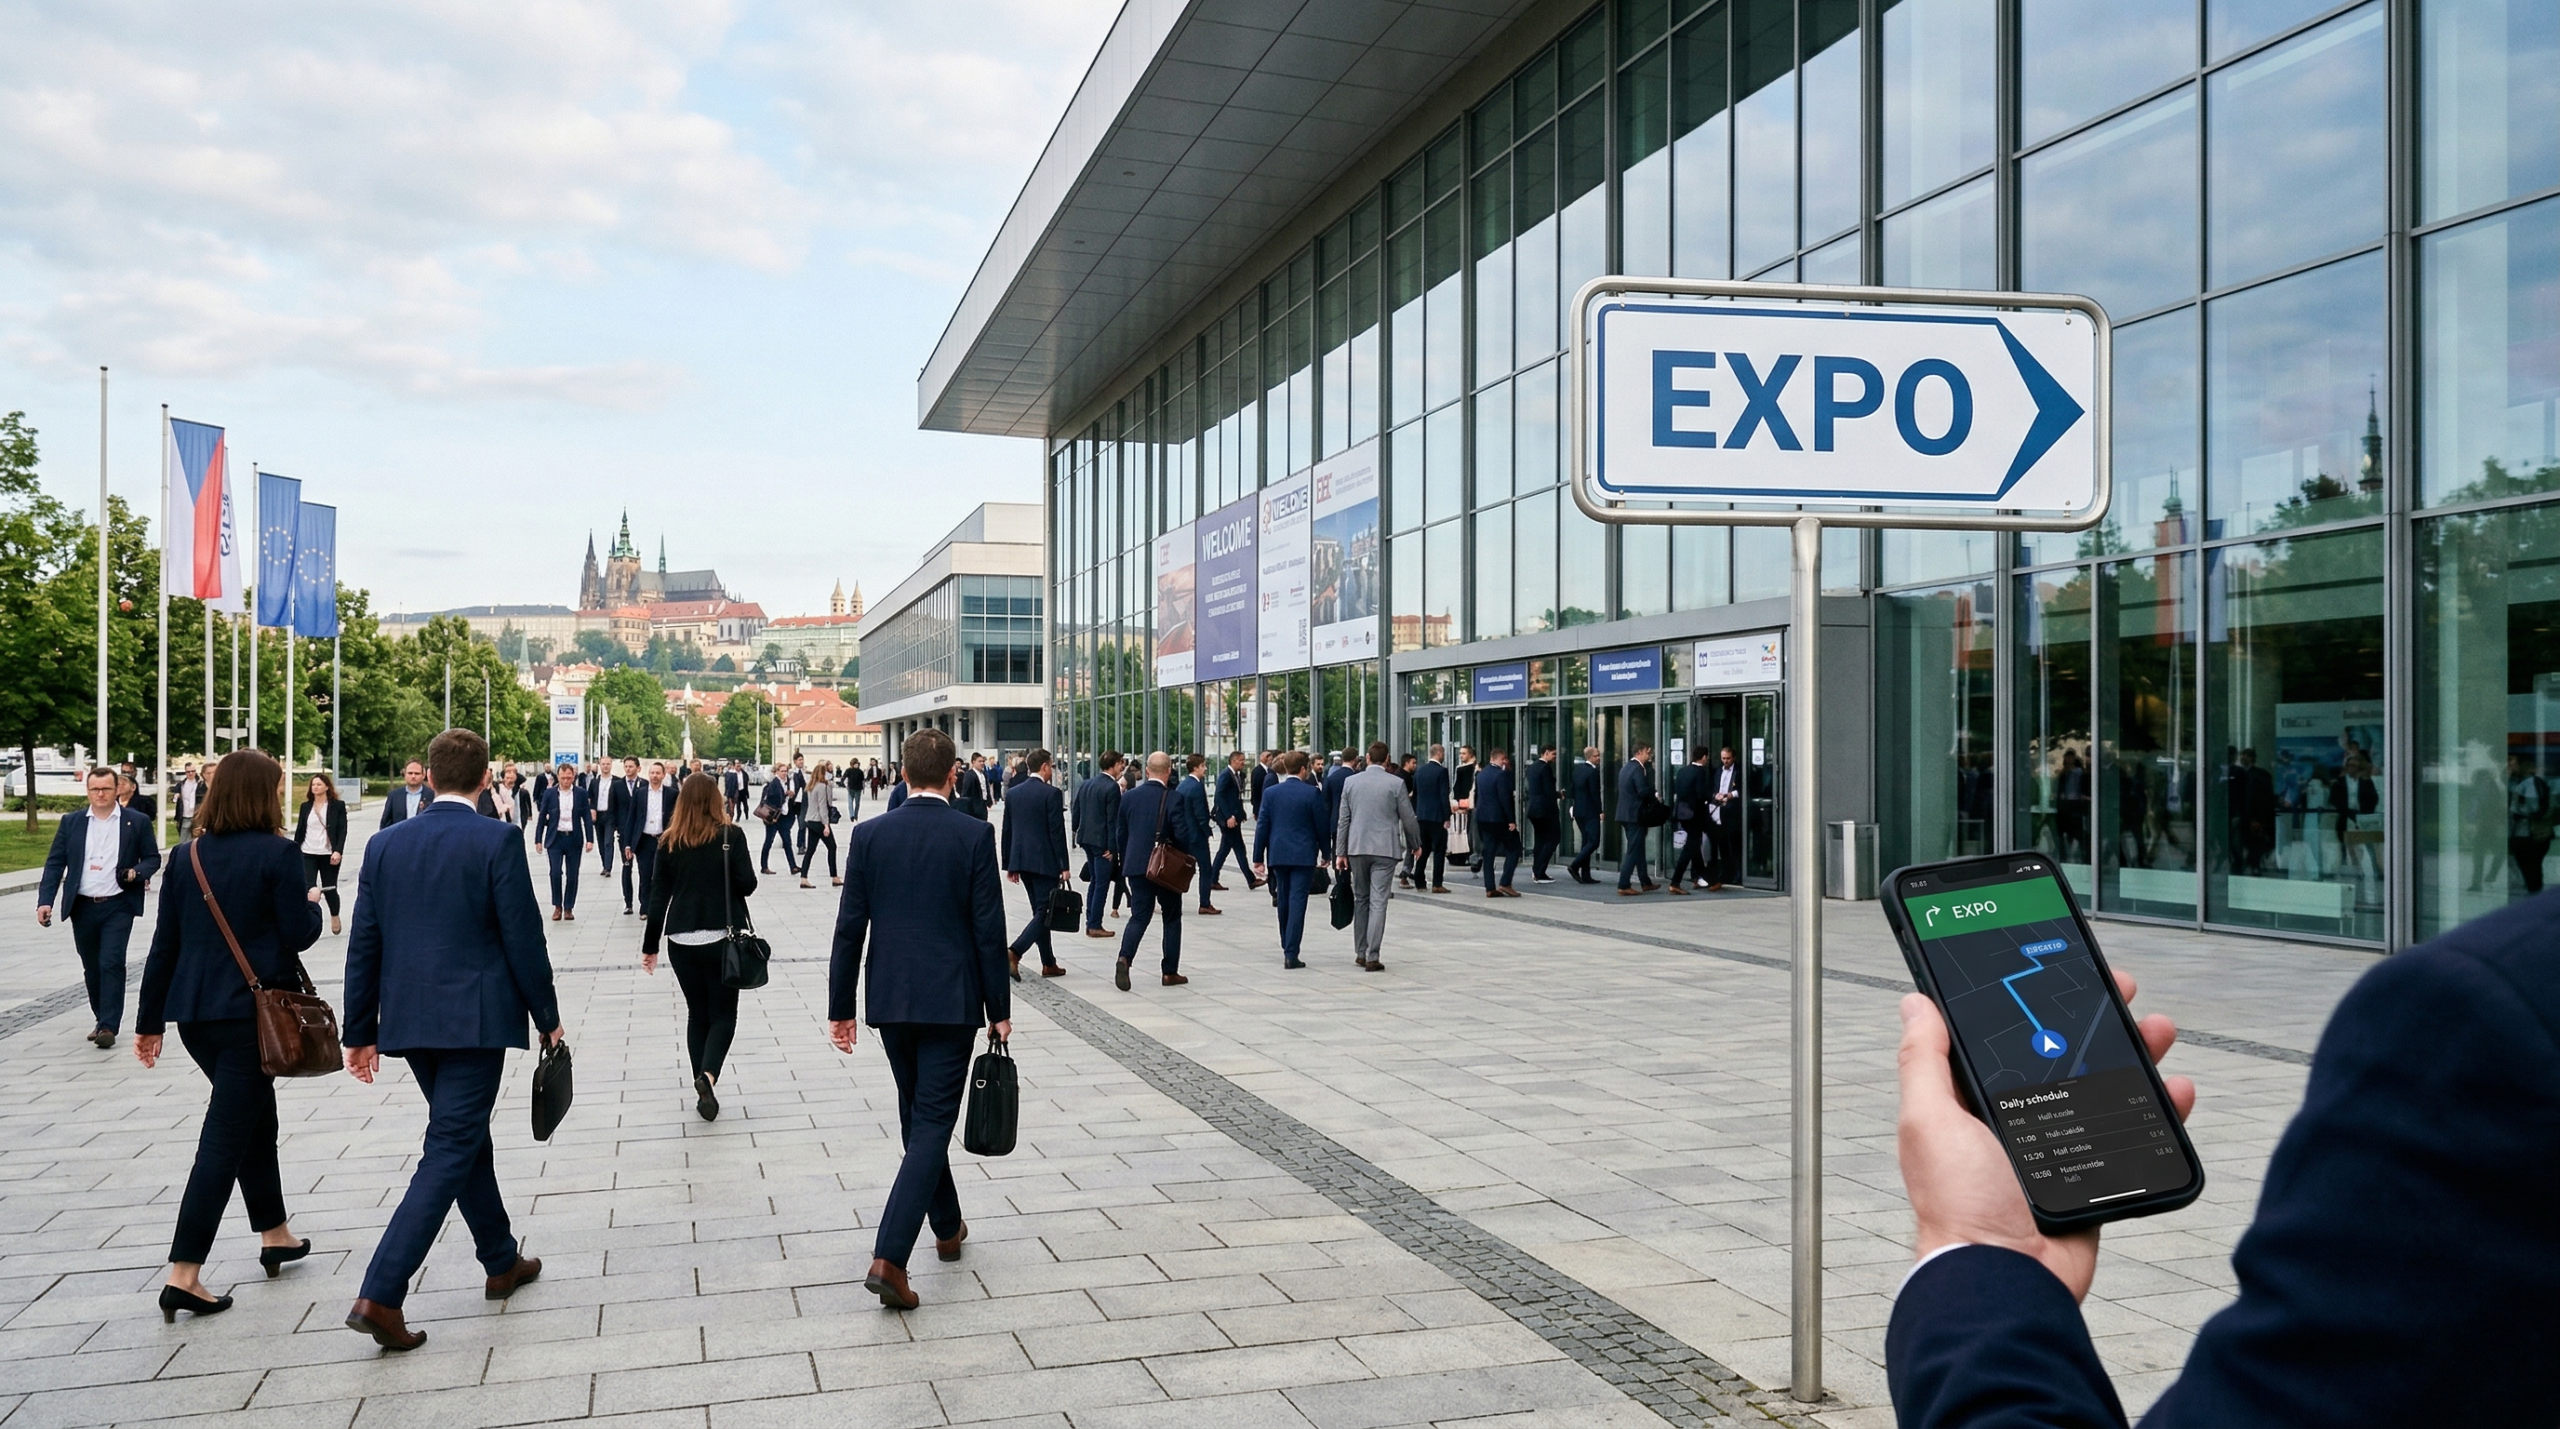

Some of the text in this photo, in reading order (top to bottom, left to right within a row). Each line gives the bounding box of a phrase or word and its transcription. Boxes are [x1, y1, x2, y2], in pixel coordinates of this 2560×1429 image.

[1651, 349, 1974, 457] EXPO
[1202, 516, 1252, 562] WELCOME
[1951, 900, 1998, 919] EXPO
